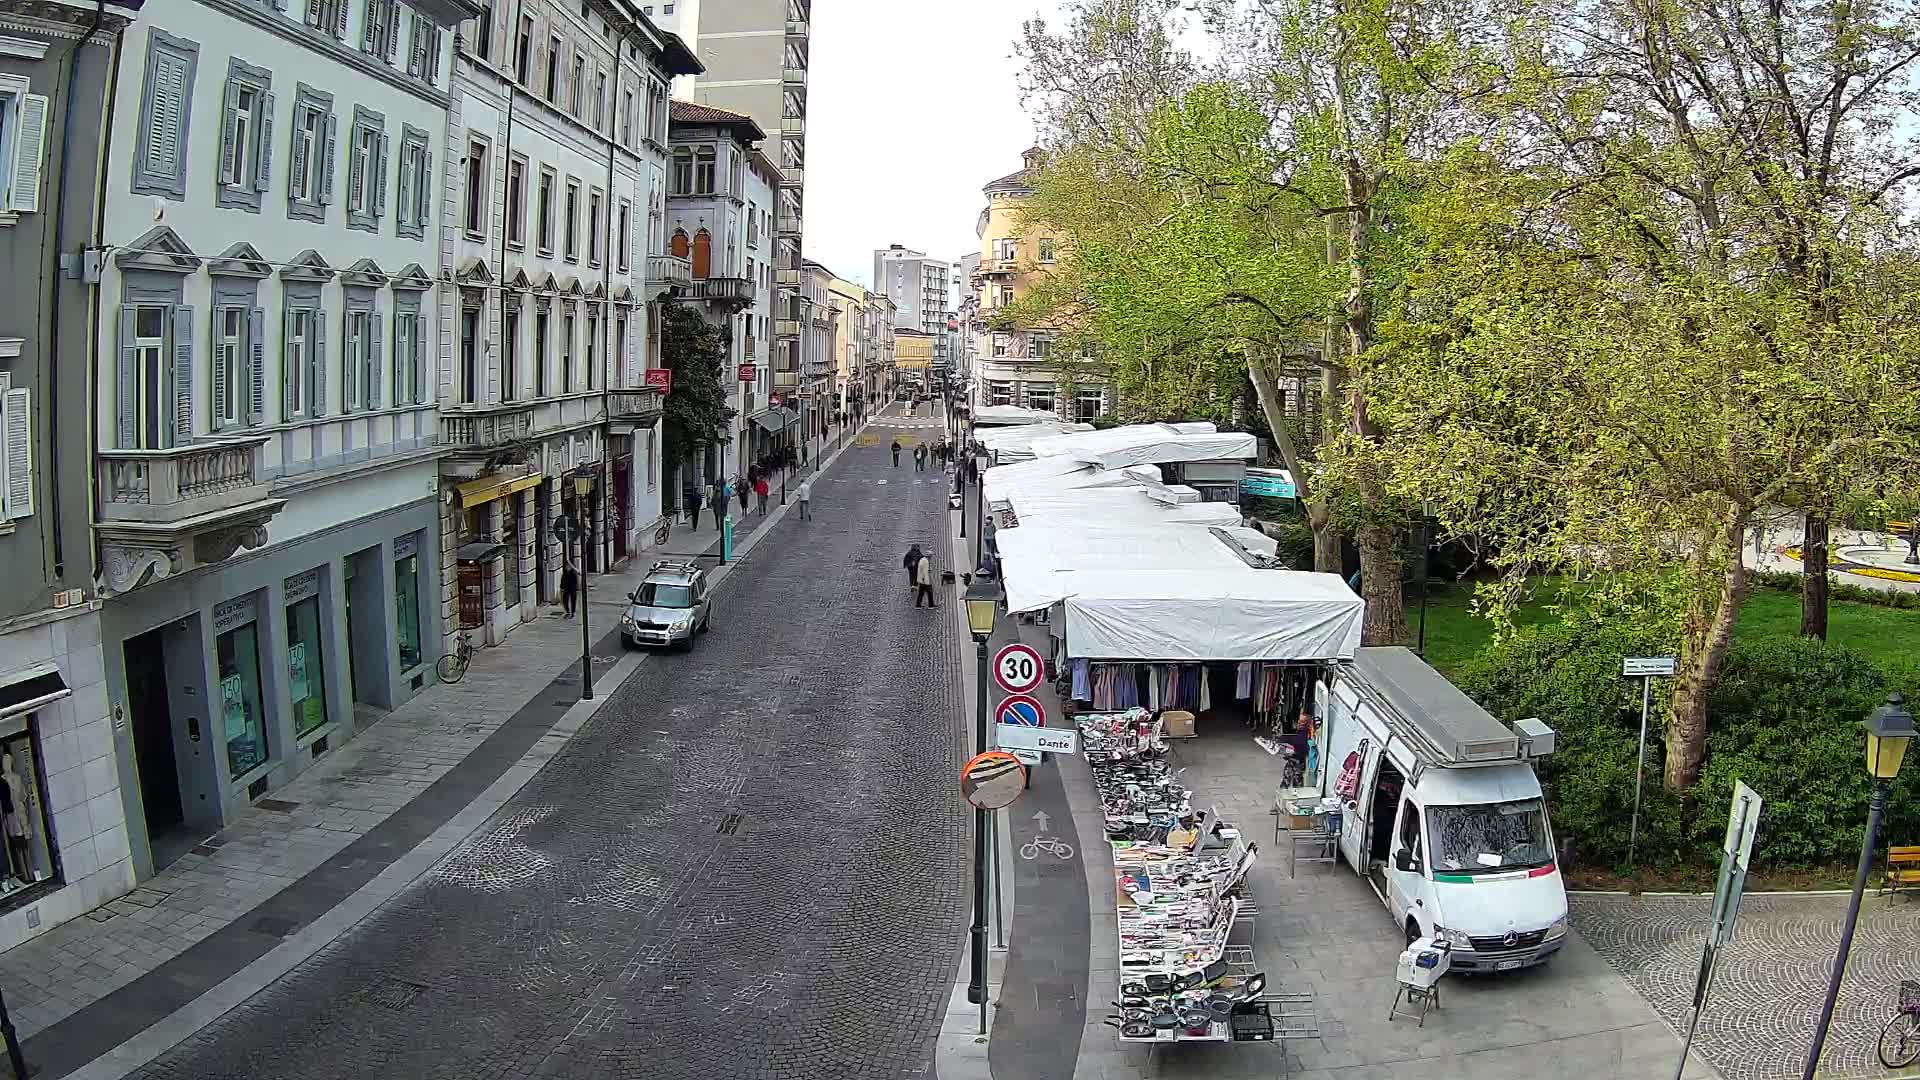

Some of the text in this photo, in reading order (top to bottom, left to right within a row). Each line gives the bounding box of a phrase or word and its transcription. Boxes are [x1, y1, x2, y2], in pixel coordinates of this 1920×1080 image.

[1005, 658, 1032, 680] 30
[222, 677, 241, 700] 130
[1038, 737, 1069, 749] Dante
